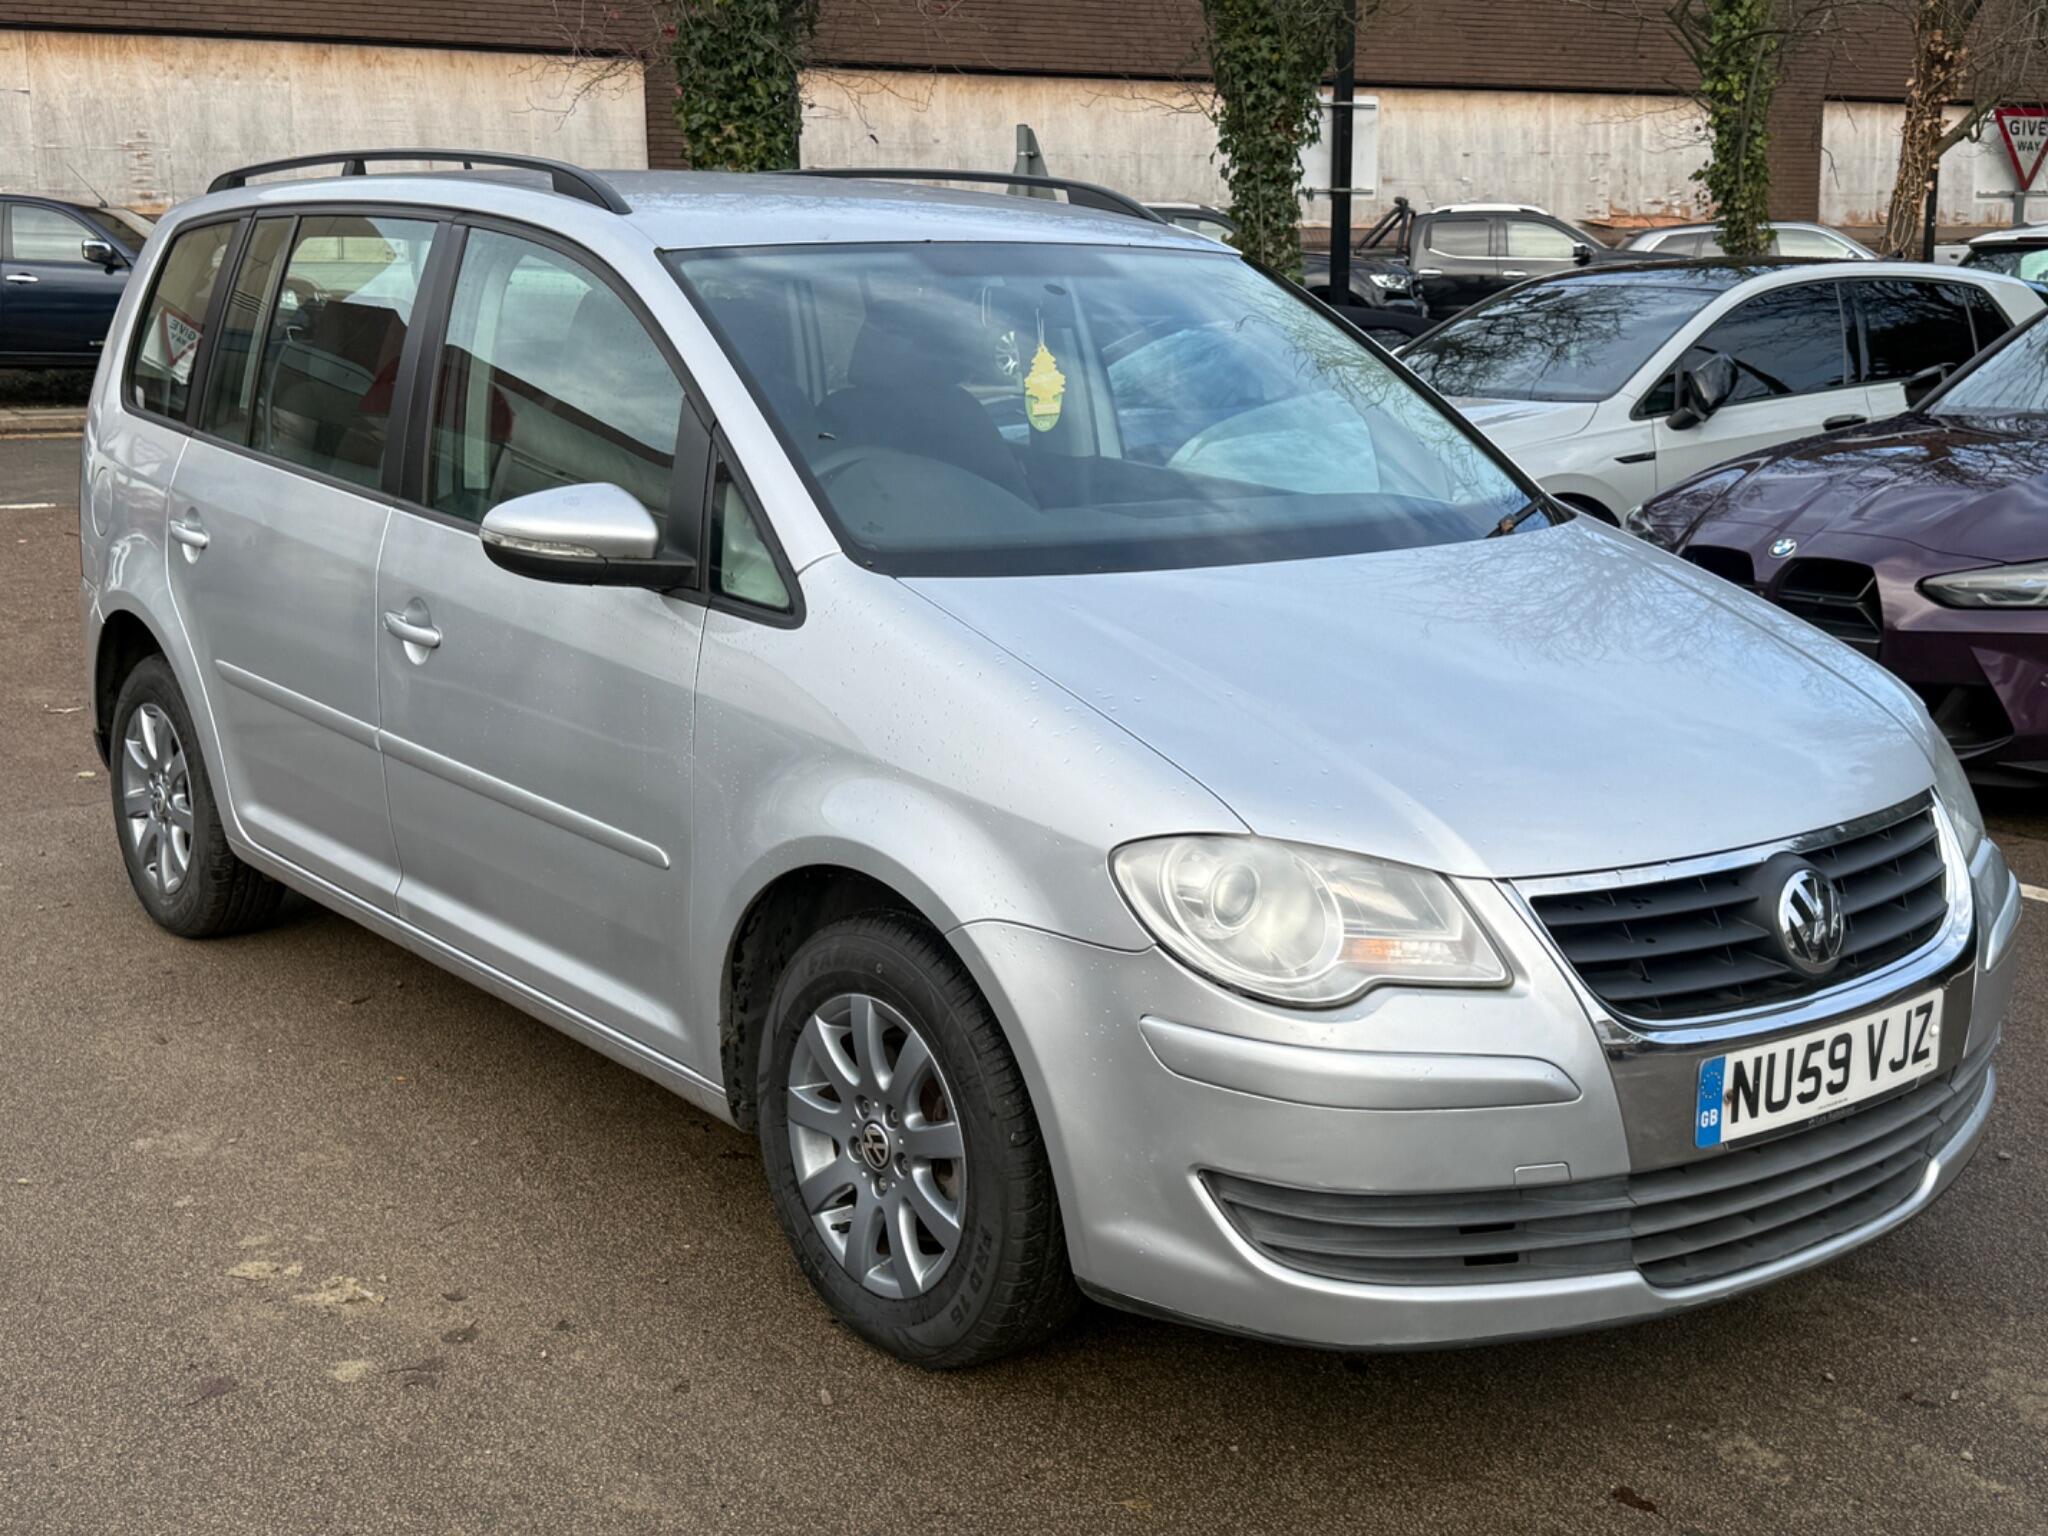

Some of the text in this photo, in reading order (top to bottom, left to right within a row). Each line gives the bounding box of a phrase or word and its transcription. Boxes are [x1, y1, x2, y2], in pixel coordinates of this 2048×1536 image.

[2010, 119, 2048, 136] GIVE
[2017, 140, 2041, 151] WAY
[1731, 1000, 1934, 1124] NU59 VJZ
[1700, 1108, 1718, 1128] GB
